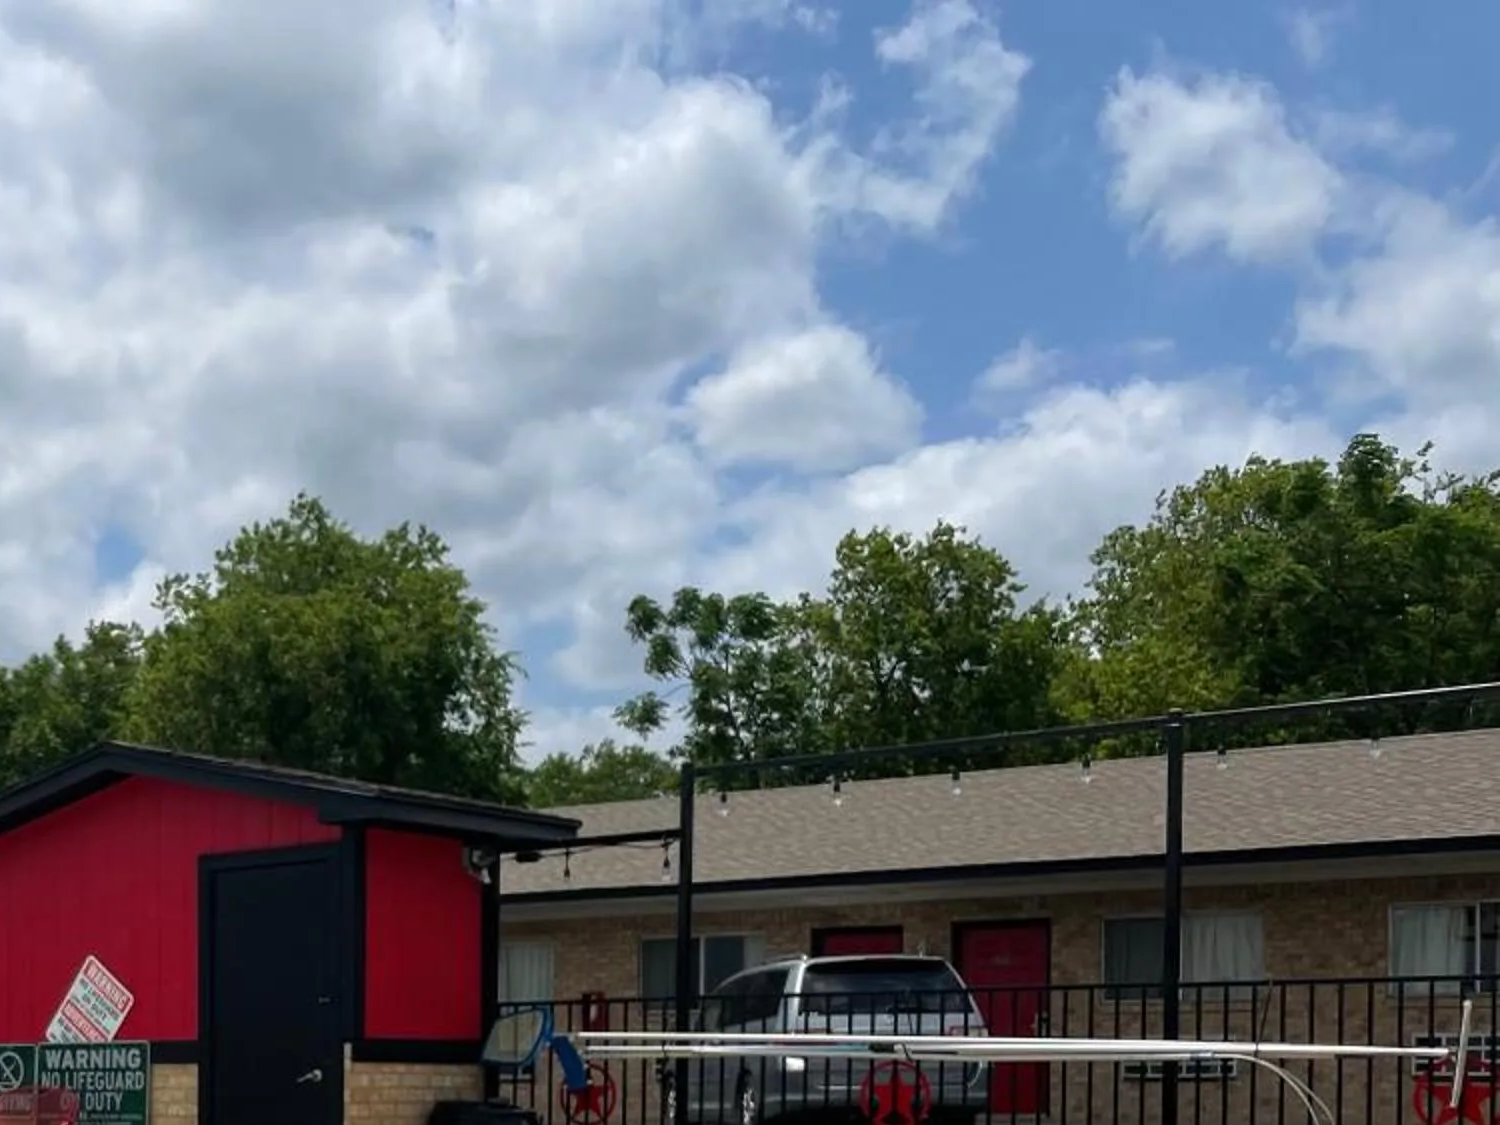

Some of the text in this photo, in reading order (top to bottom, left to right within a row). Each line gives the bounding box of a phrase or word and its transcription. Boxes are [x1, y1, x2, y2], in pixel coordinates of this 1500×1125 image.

[45, 1048, 141, 1069] WARNING
[41, 1071, 145, 1090] NO LIFEGUARD
[85, 1091, 123, 1111] DUTY
